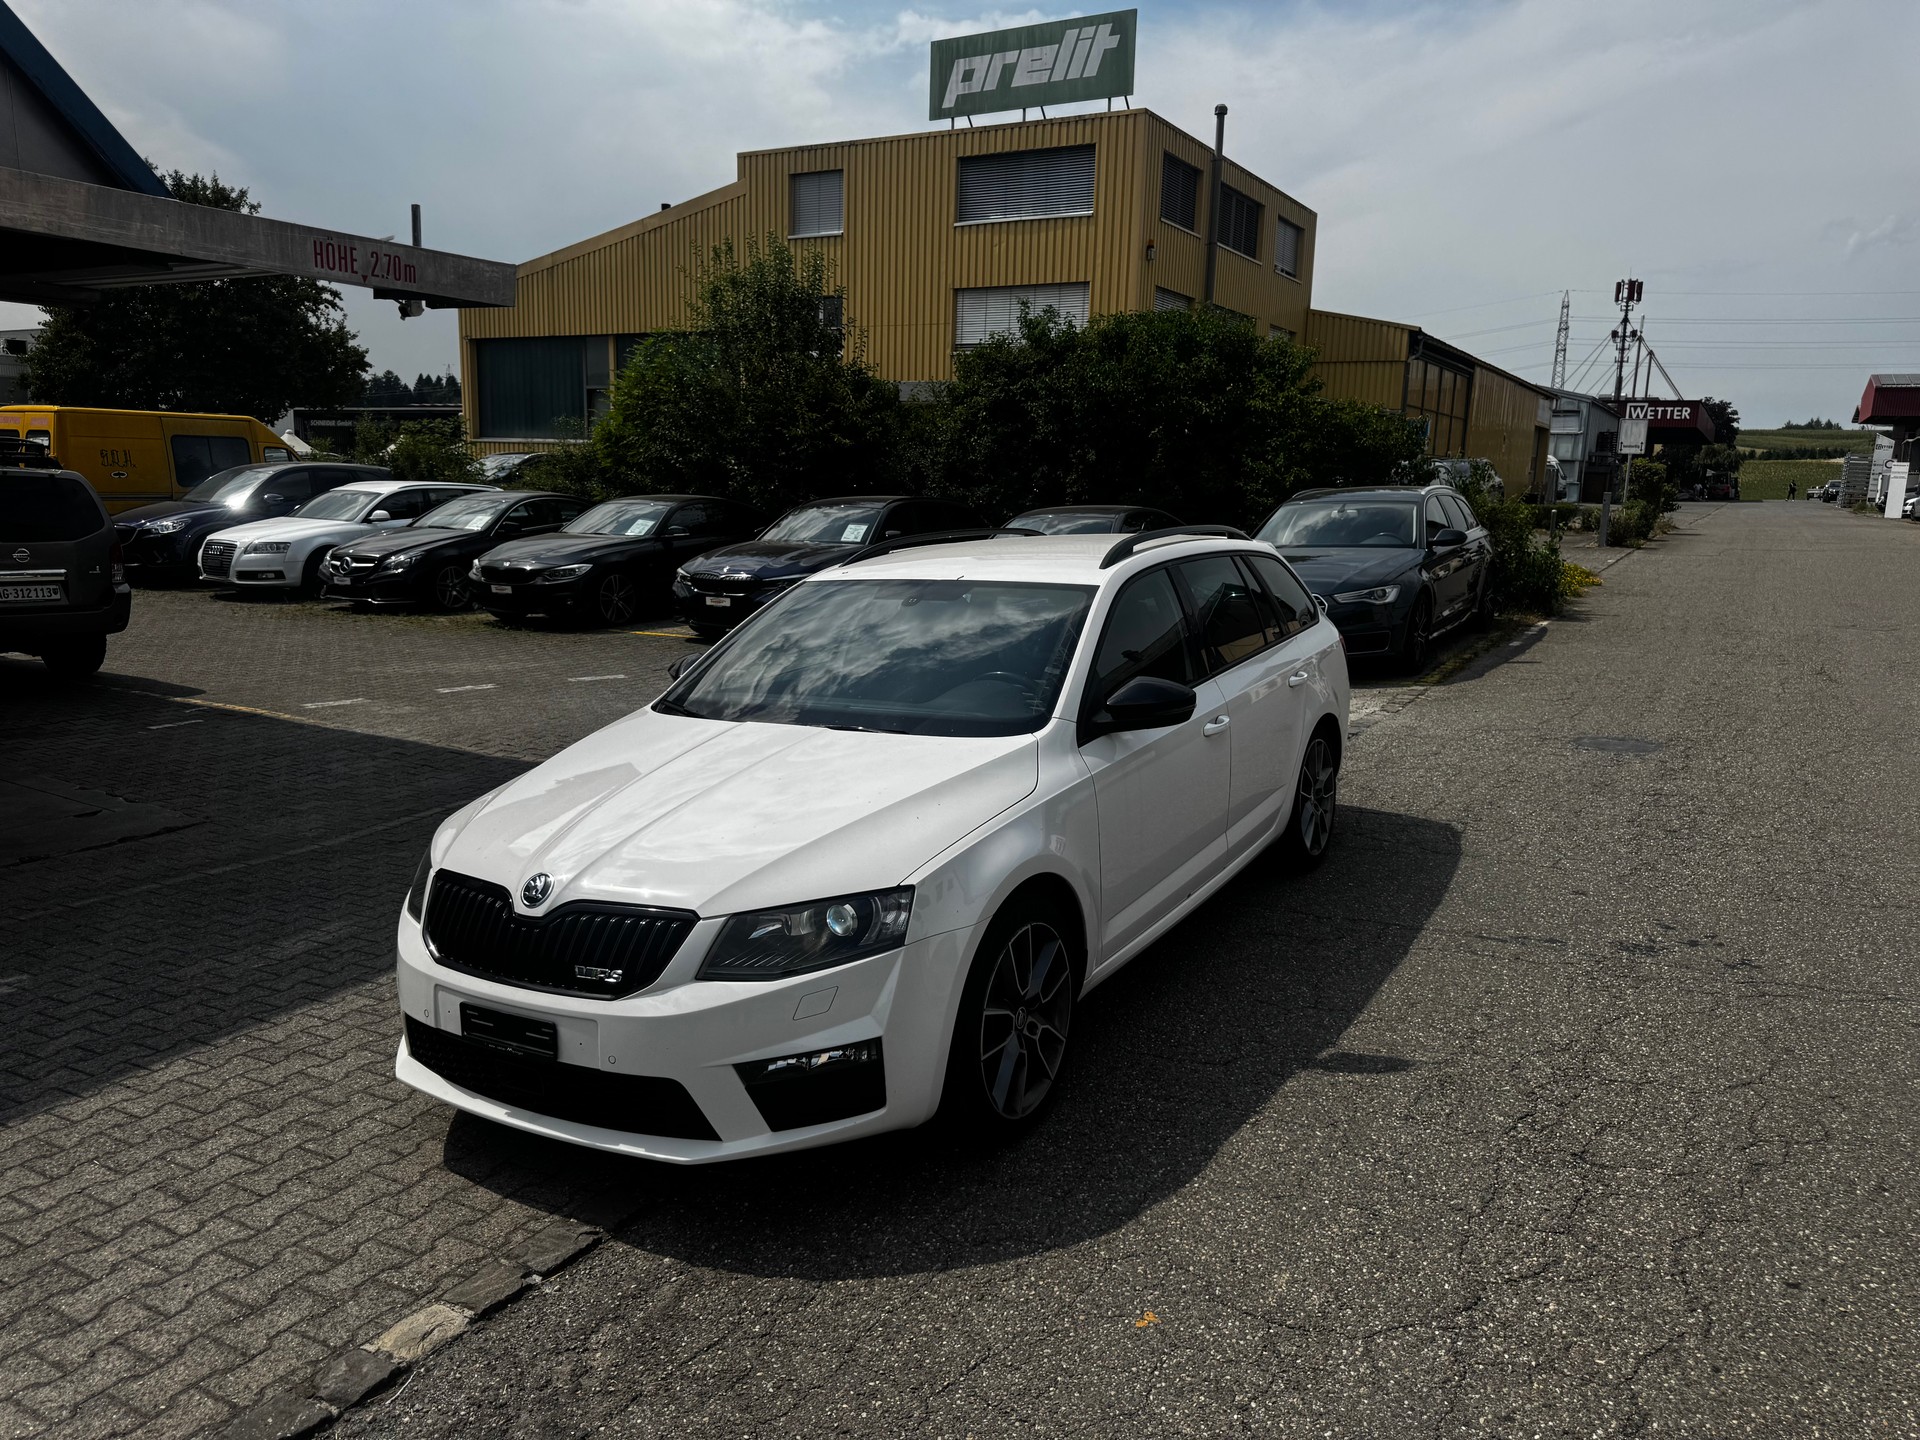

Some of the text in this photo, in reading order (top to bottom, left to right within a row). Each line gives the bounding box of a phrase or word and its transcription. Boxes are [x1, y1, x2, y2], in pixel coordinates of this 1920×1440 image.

[941, 23, 1120, 109] prelit
[313, 236, 358, 274] HÖHE
[1625, 403, 1691, 419] WETTER
